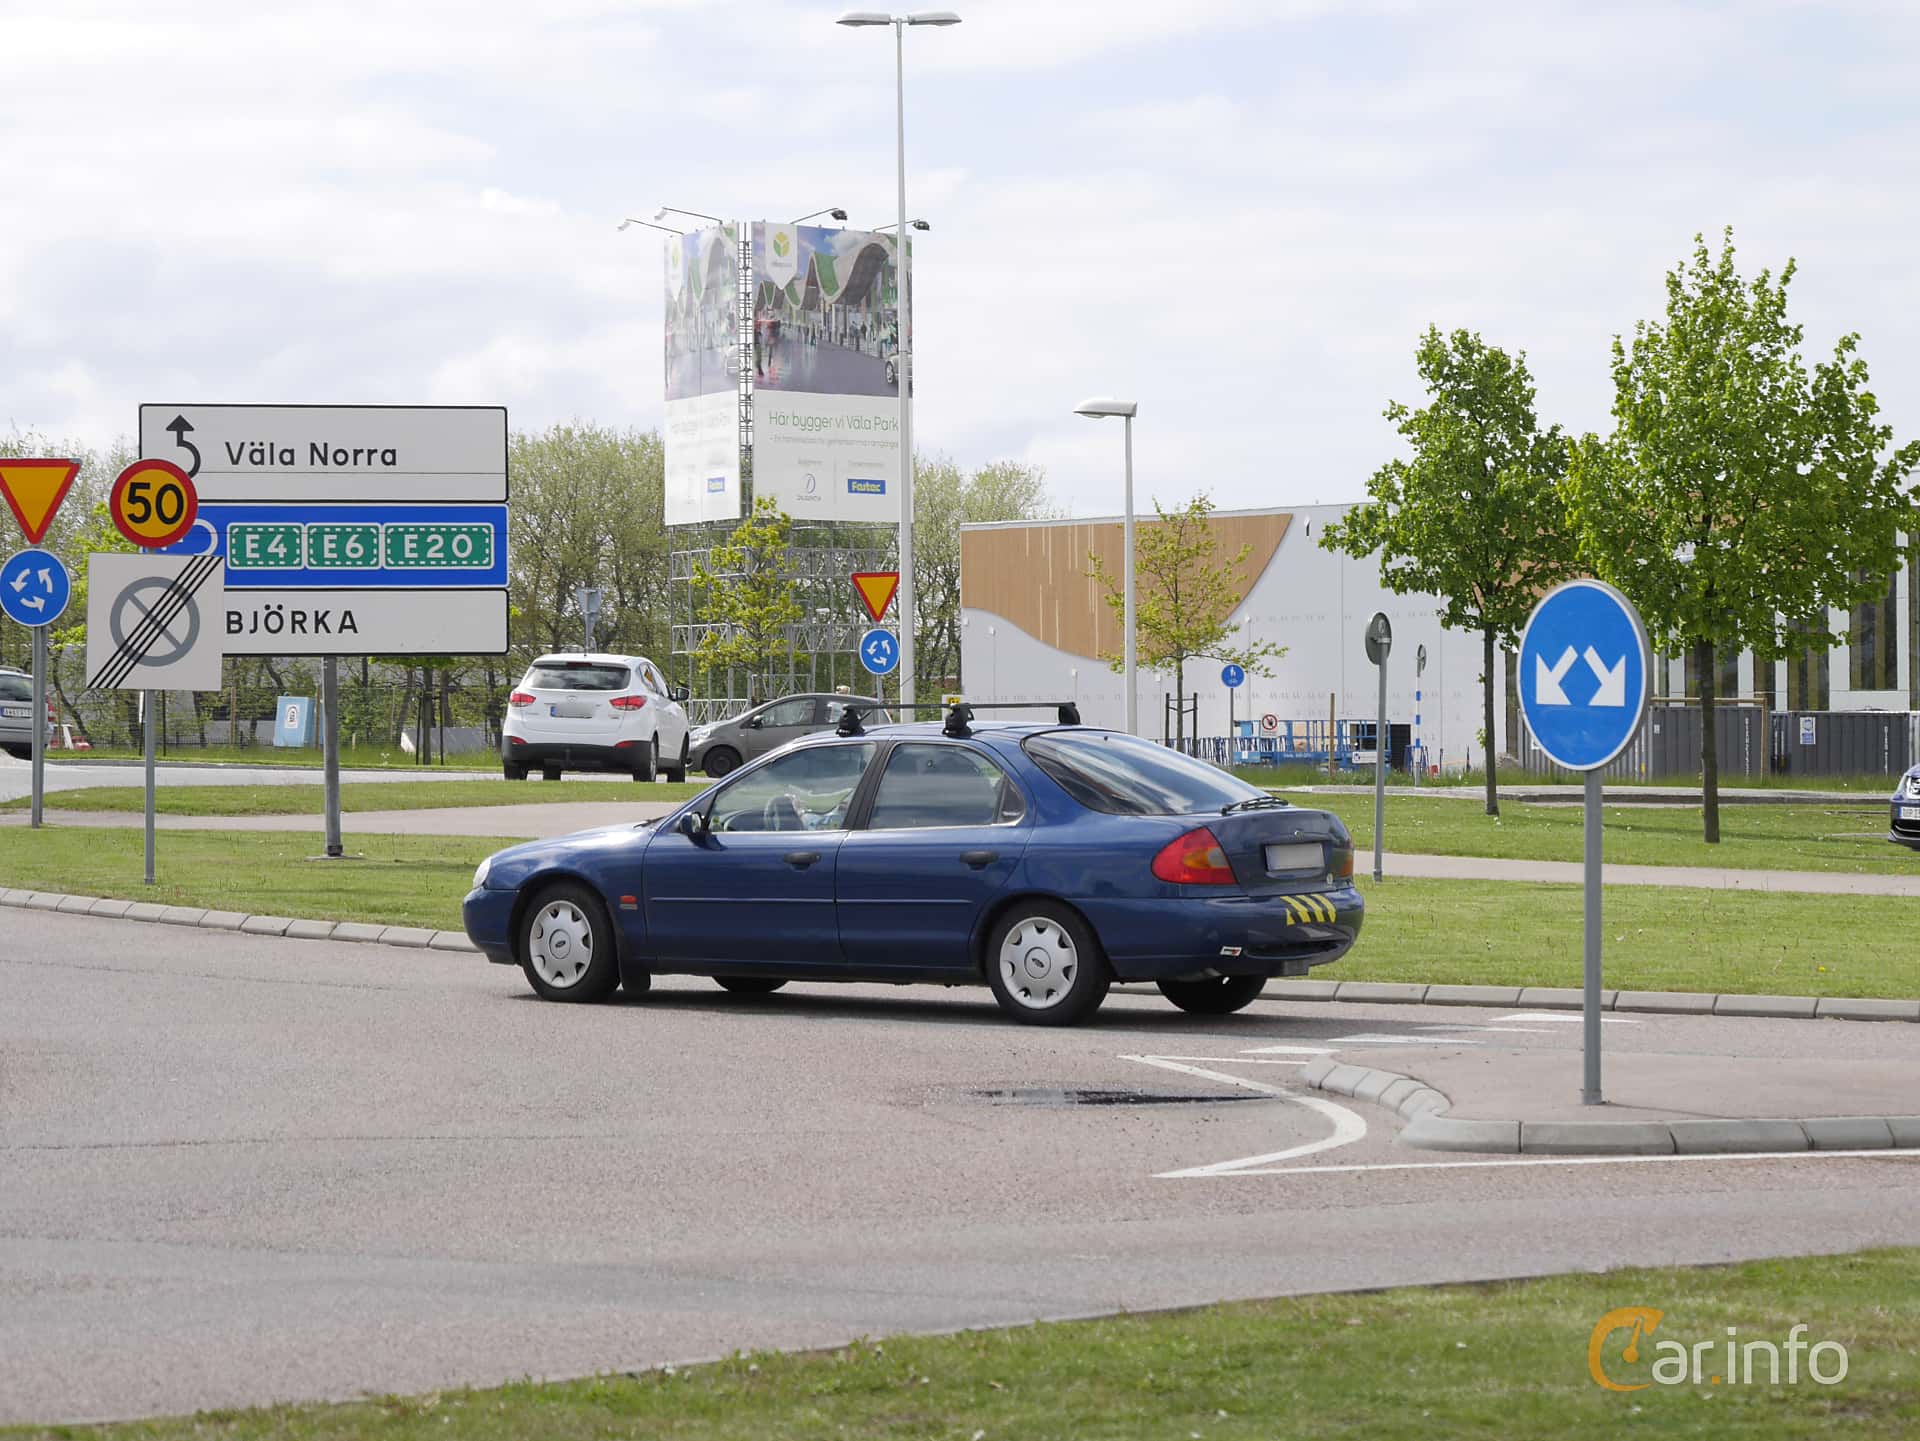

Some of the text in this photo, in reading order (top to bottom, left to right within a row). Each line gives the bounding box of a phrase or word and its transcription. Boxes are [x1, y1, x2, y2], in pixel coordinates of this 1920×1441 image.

[769, 410, 899, 432] Här bygger vi Väla Park
[225, 441, 397, 466] Väla Norra
[127, 481, 184, 525] 50
[245, 534, 288, 559] E4
[323, 534, 365, 559] E6
[403, 533, 473, 559] E20
[225, 604, 359, 634] BJÖRKA
